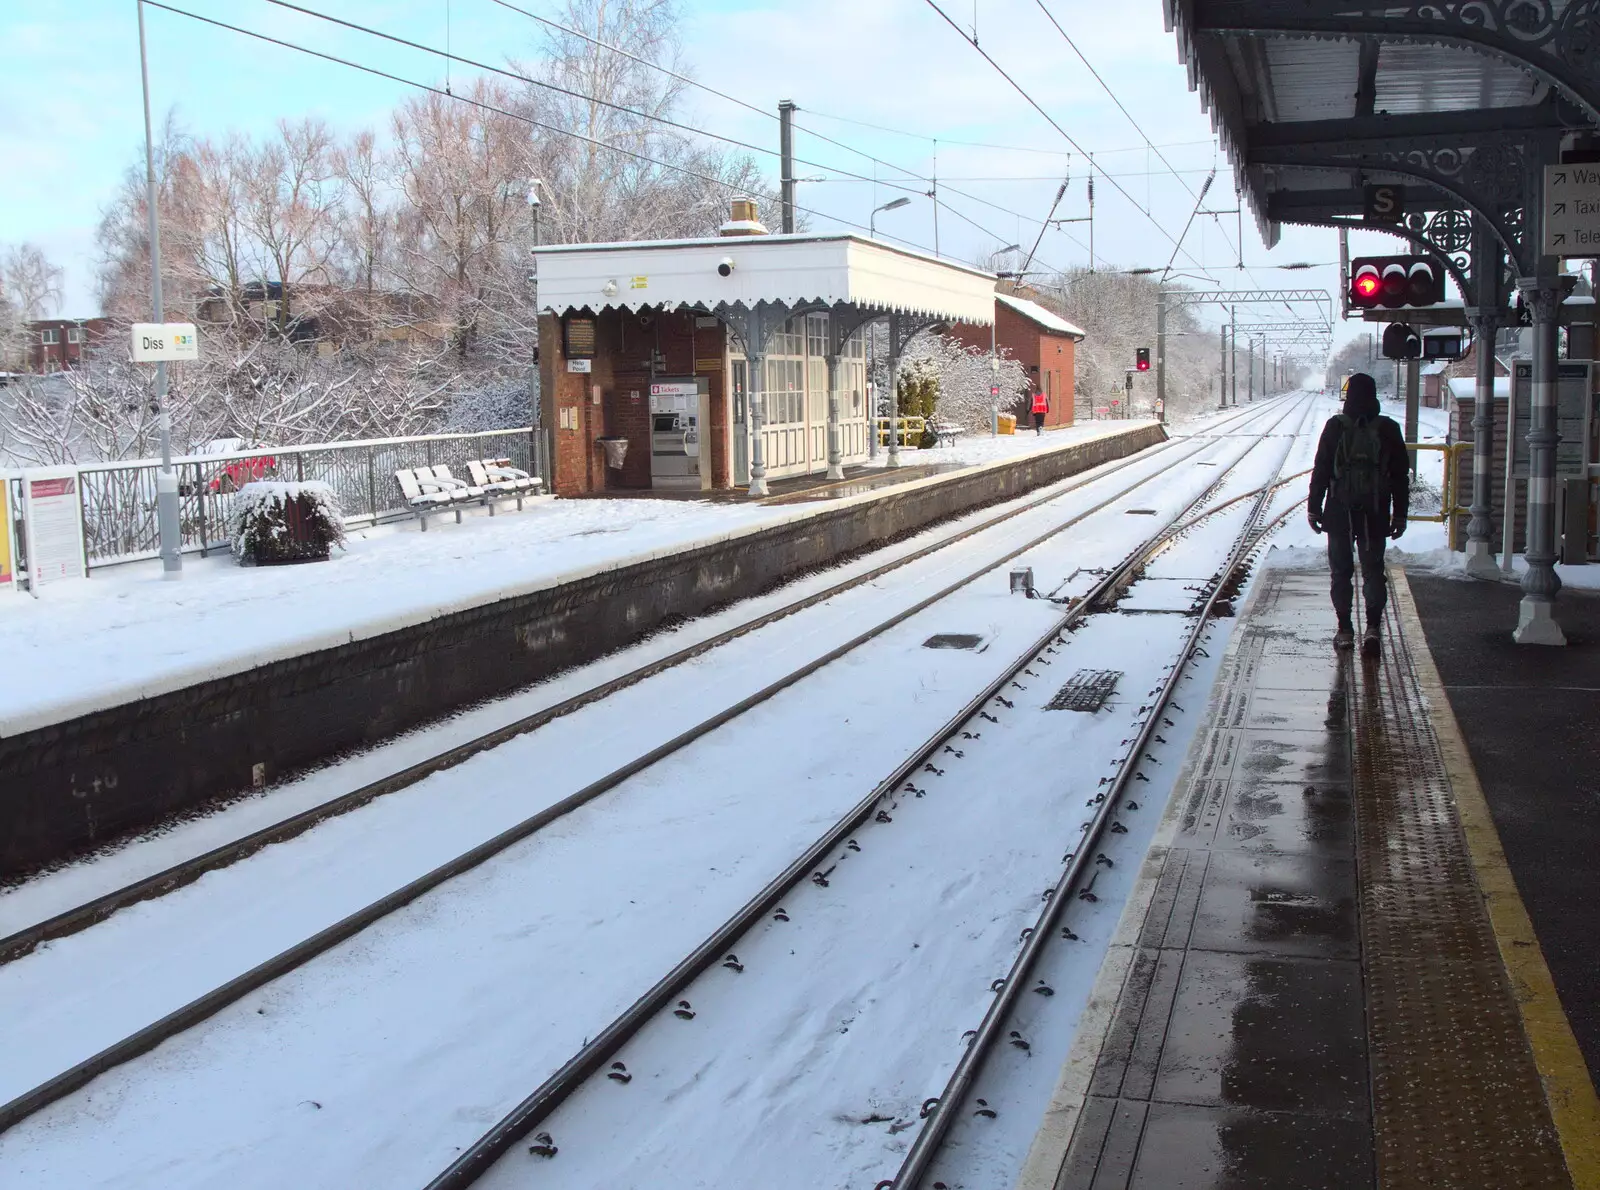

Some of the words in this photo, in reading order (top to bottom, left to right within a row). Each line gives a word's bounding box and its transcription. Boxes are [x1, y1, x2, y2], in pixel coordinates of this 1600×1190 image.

[1373, 188, 1394, 213] S
[1573, 199, 1600, 214] Taxi
[1573, 229, 1600, 244] Tele
[1520, 311, 1529, 322] 4
[142, 335, 164, 350] Diss
